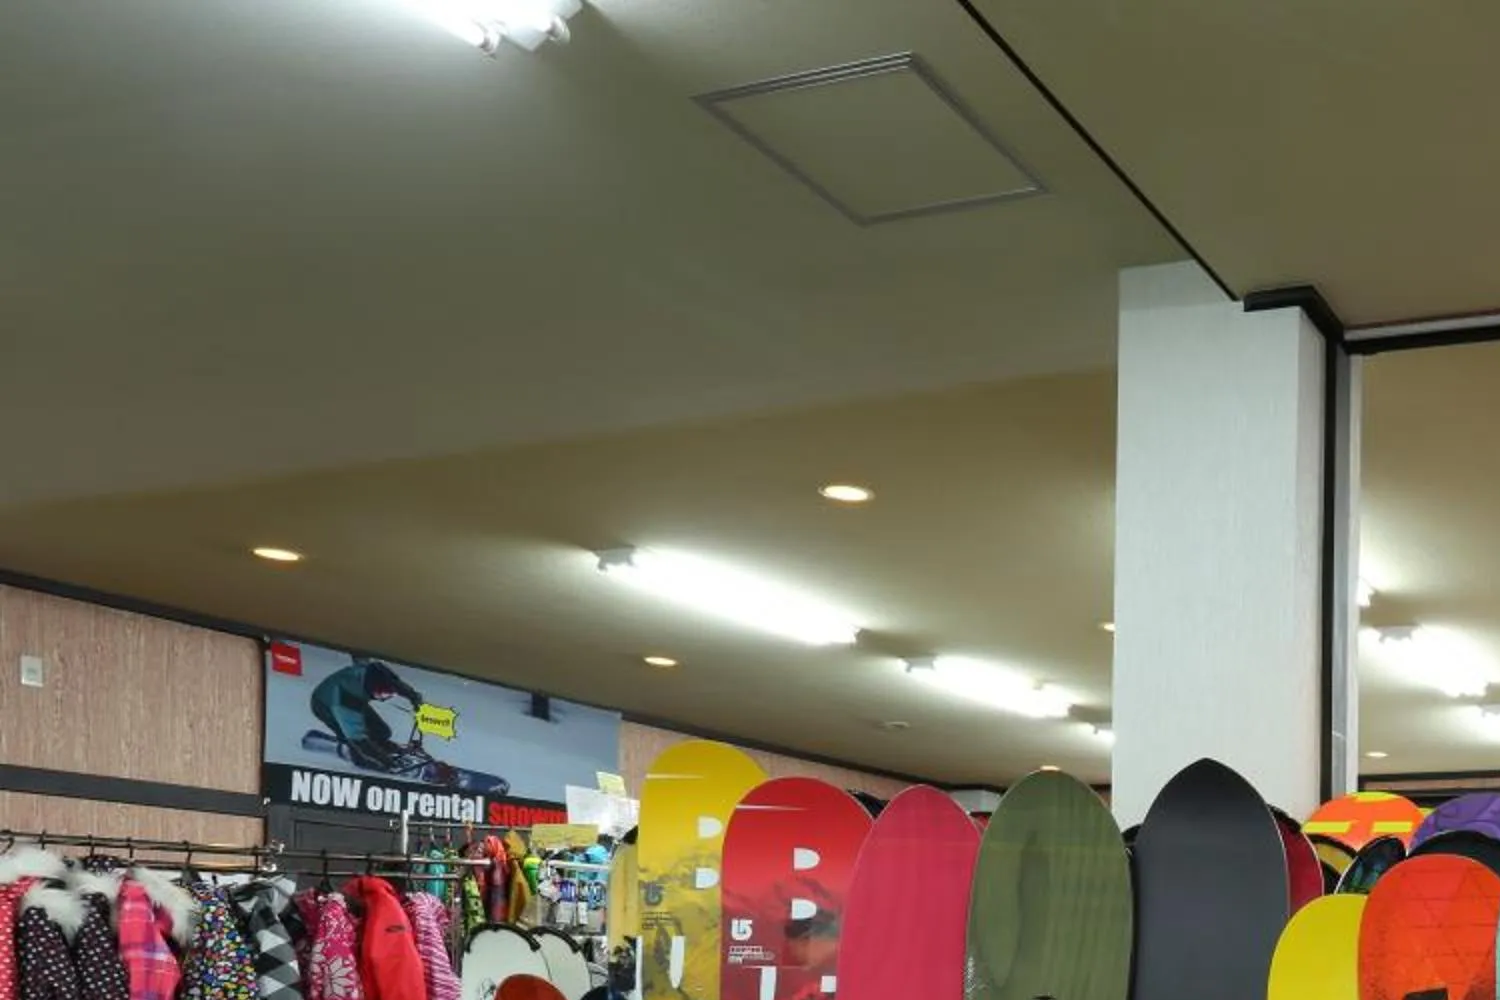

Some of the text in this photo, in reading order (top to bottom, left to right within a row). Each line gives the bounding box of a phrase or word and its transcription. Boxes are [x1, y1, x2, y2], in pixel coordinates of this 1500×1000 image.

[291, 769, 363, 810] NOW
[366, 785, 402, 814] on
[405, 791, 483, 824] rental
